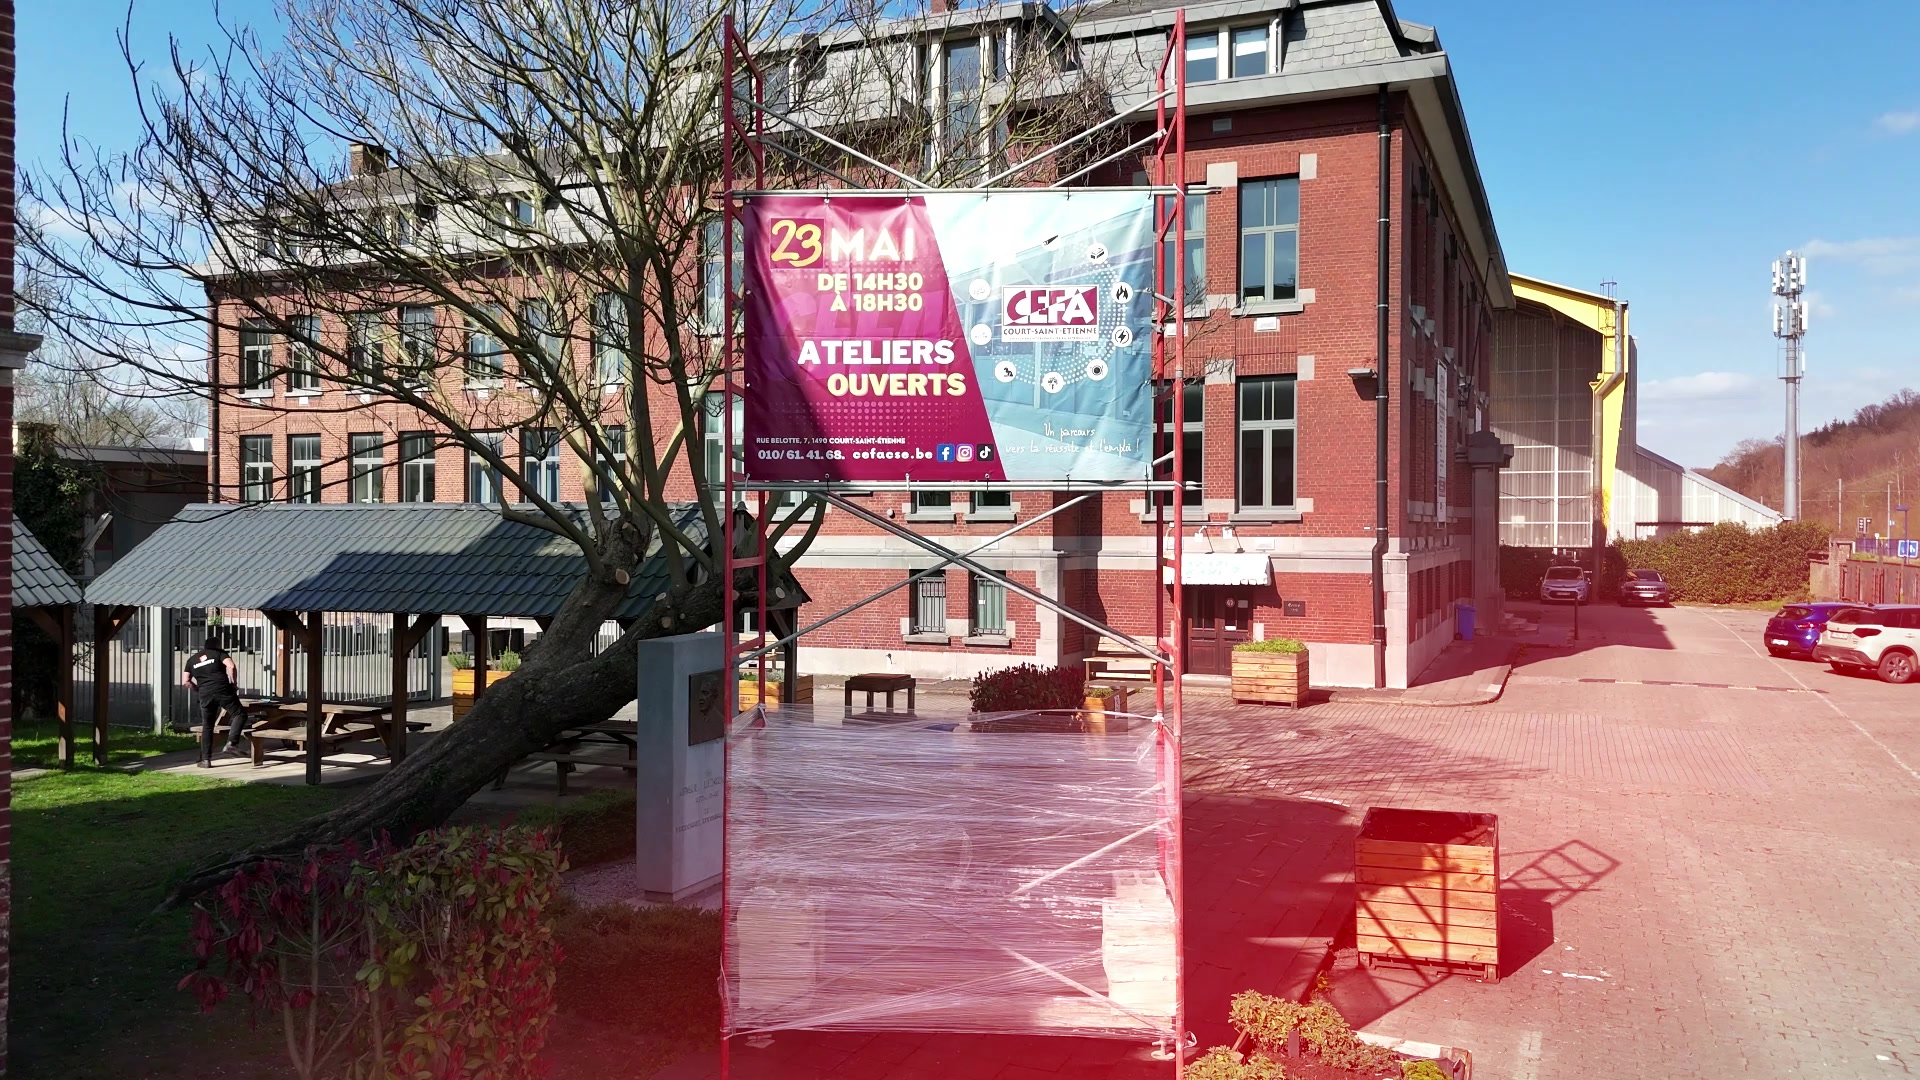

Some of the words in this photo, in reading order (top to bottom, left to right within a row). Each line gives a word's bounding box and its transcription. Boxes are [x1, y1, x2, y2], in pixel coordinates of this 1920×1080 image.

[771, 219, 822, 267] 23
[831, 228, 914, 262] MAI
[818, 273, 847, 291] DE
[853, 273, 922, 291] 14H30
[830, 290, 847, 311] À
[853, 293, 922, 311] 18H30
[1006, 288, 1095, 325] CEFA
[798, 340, 954, 365] ATELIERS
[827, 373, 967, 396] OUVERTS
[771, 437, 802, 445] BELOTTE,
[1060, 427, 1096, 442] parcours
[758, 449, 784, 461] 010/
[786, 450, 805, 460] 61.
[806, 450, 825, 460] 41.
[852, 448, 933, 460] cefacse.be
[1005, 444, 1025, 453] vers
[1030, 439, 1040, 453] la
[1045, 440, 1080, 453] réussite
